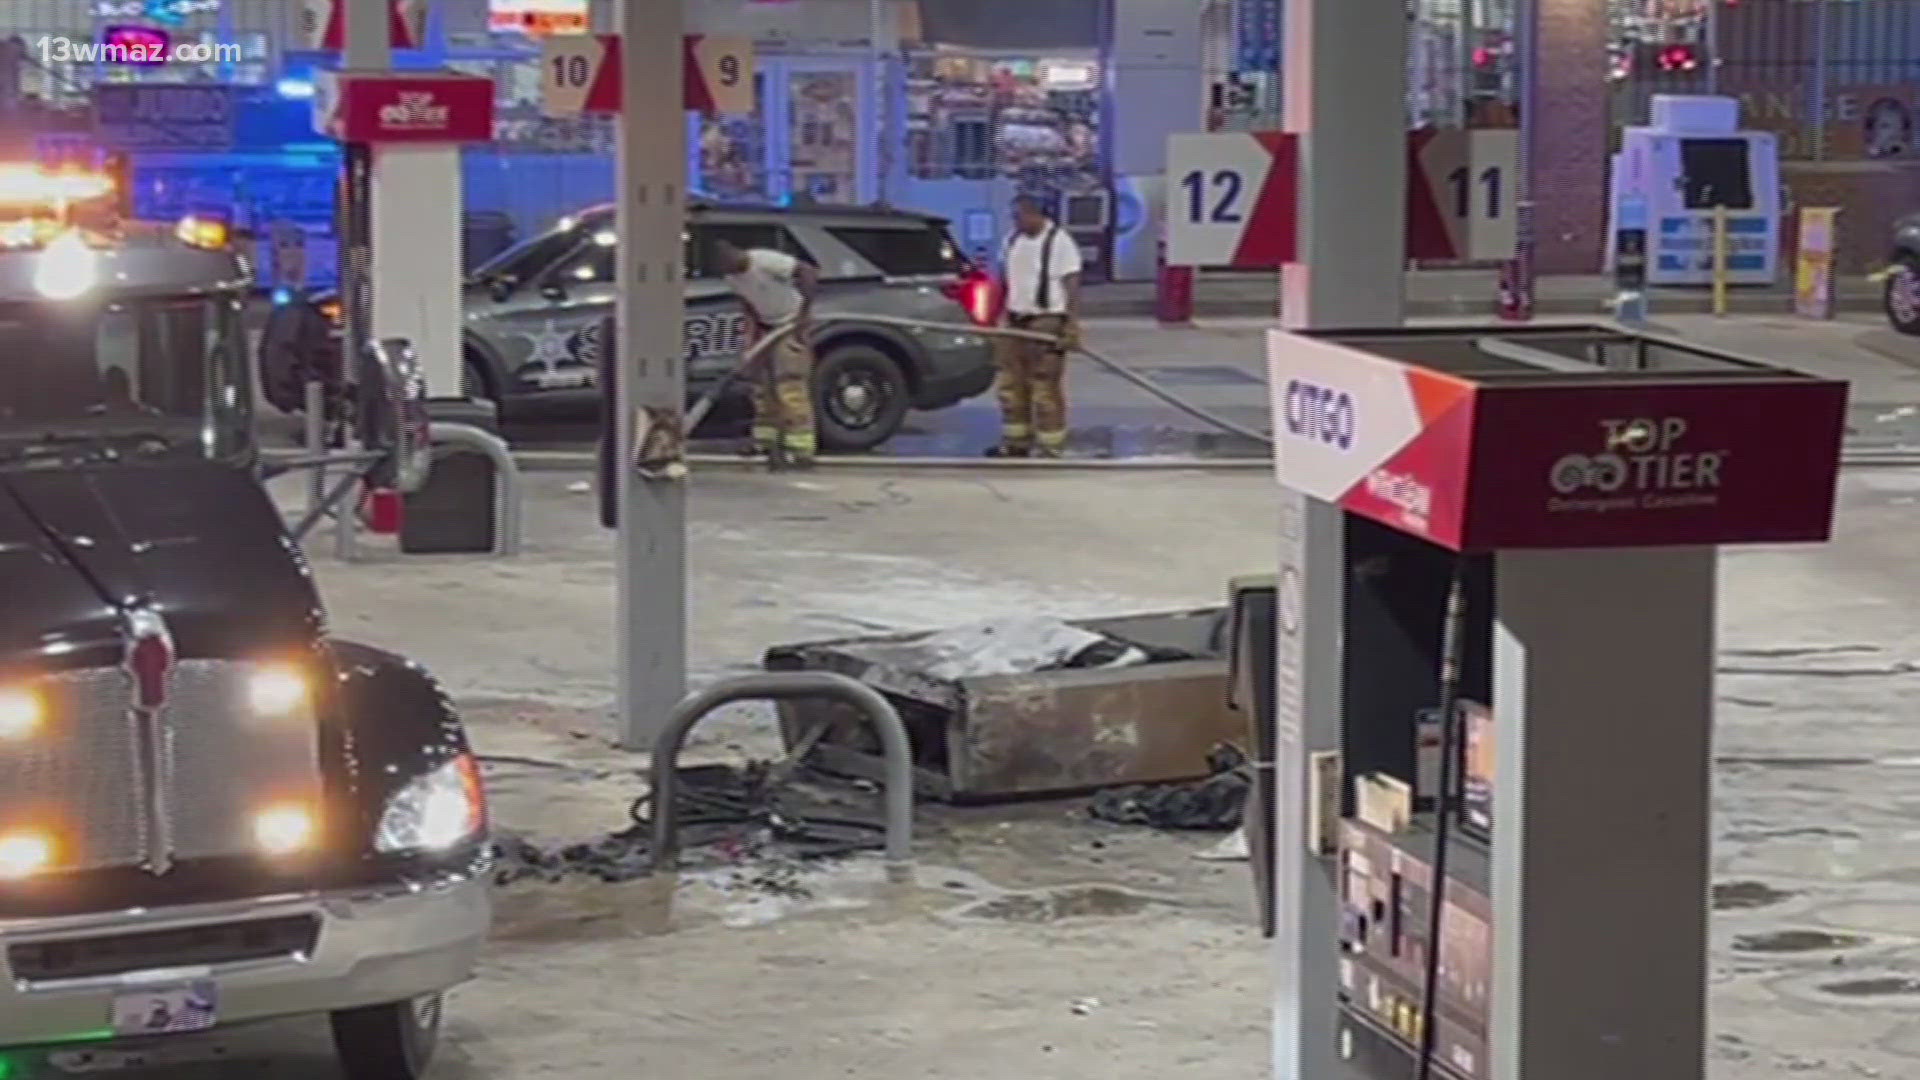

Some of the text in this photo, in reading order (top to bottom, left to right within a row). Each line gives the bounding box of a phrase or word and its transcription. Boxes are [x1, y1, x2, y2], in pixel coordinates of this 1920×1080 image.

[552, 55, 589, 88] 10
[719, 55, 740, 88] 9
[1181, 169, 1243, 223] 12
[1446, 166, 1501, 218] 11
[1286, 378, 1356, 450] CITGO
[1599, 416, 1688, 451] TOP
[1630, 451, 1722, 489] TIER
